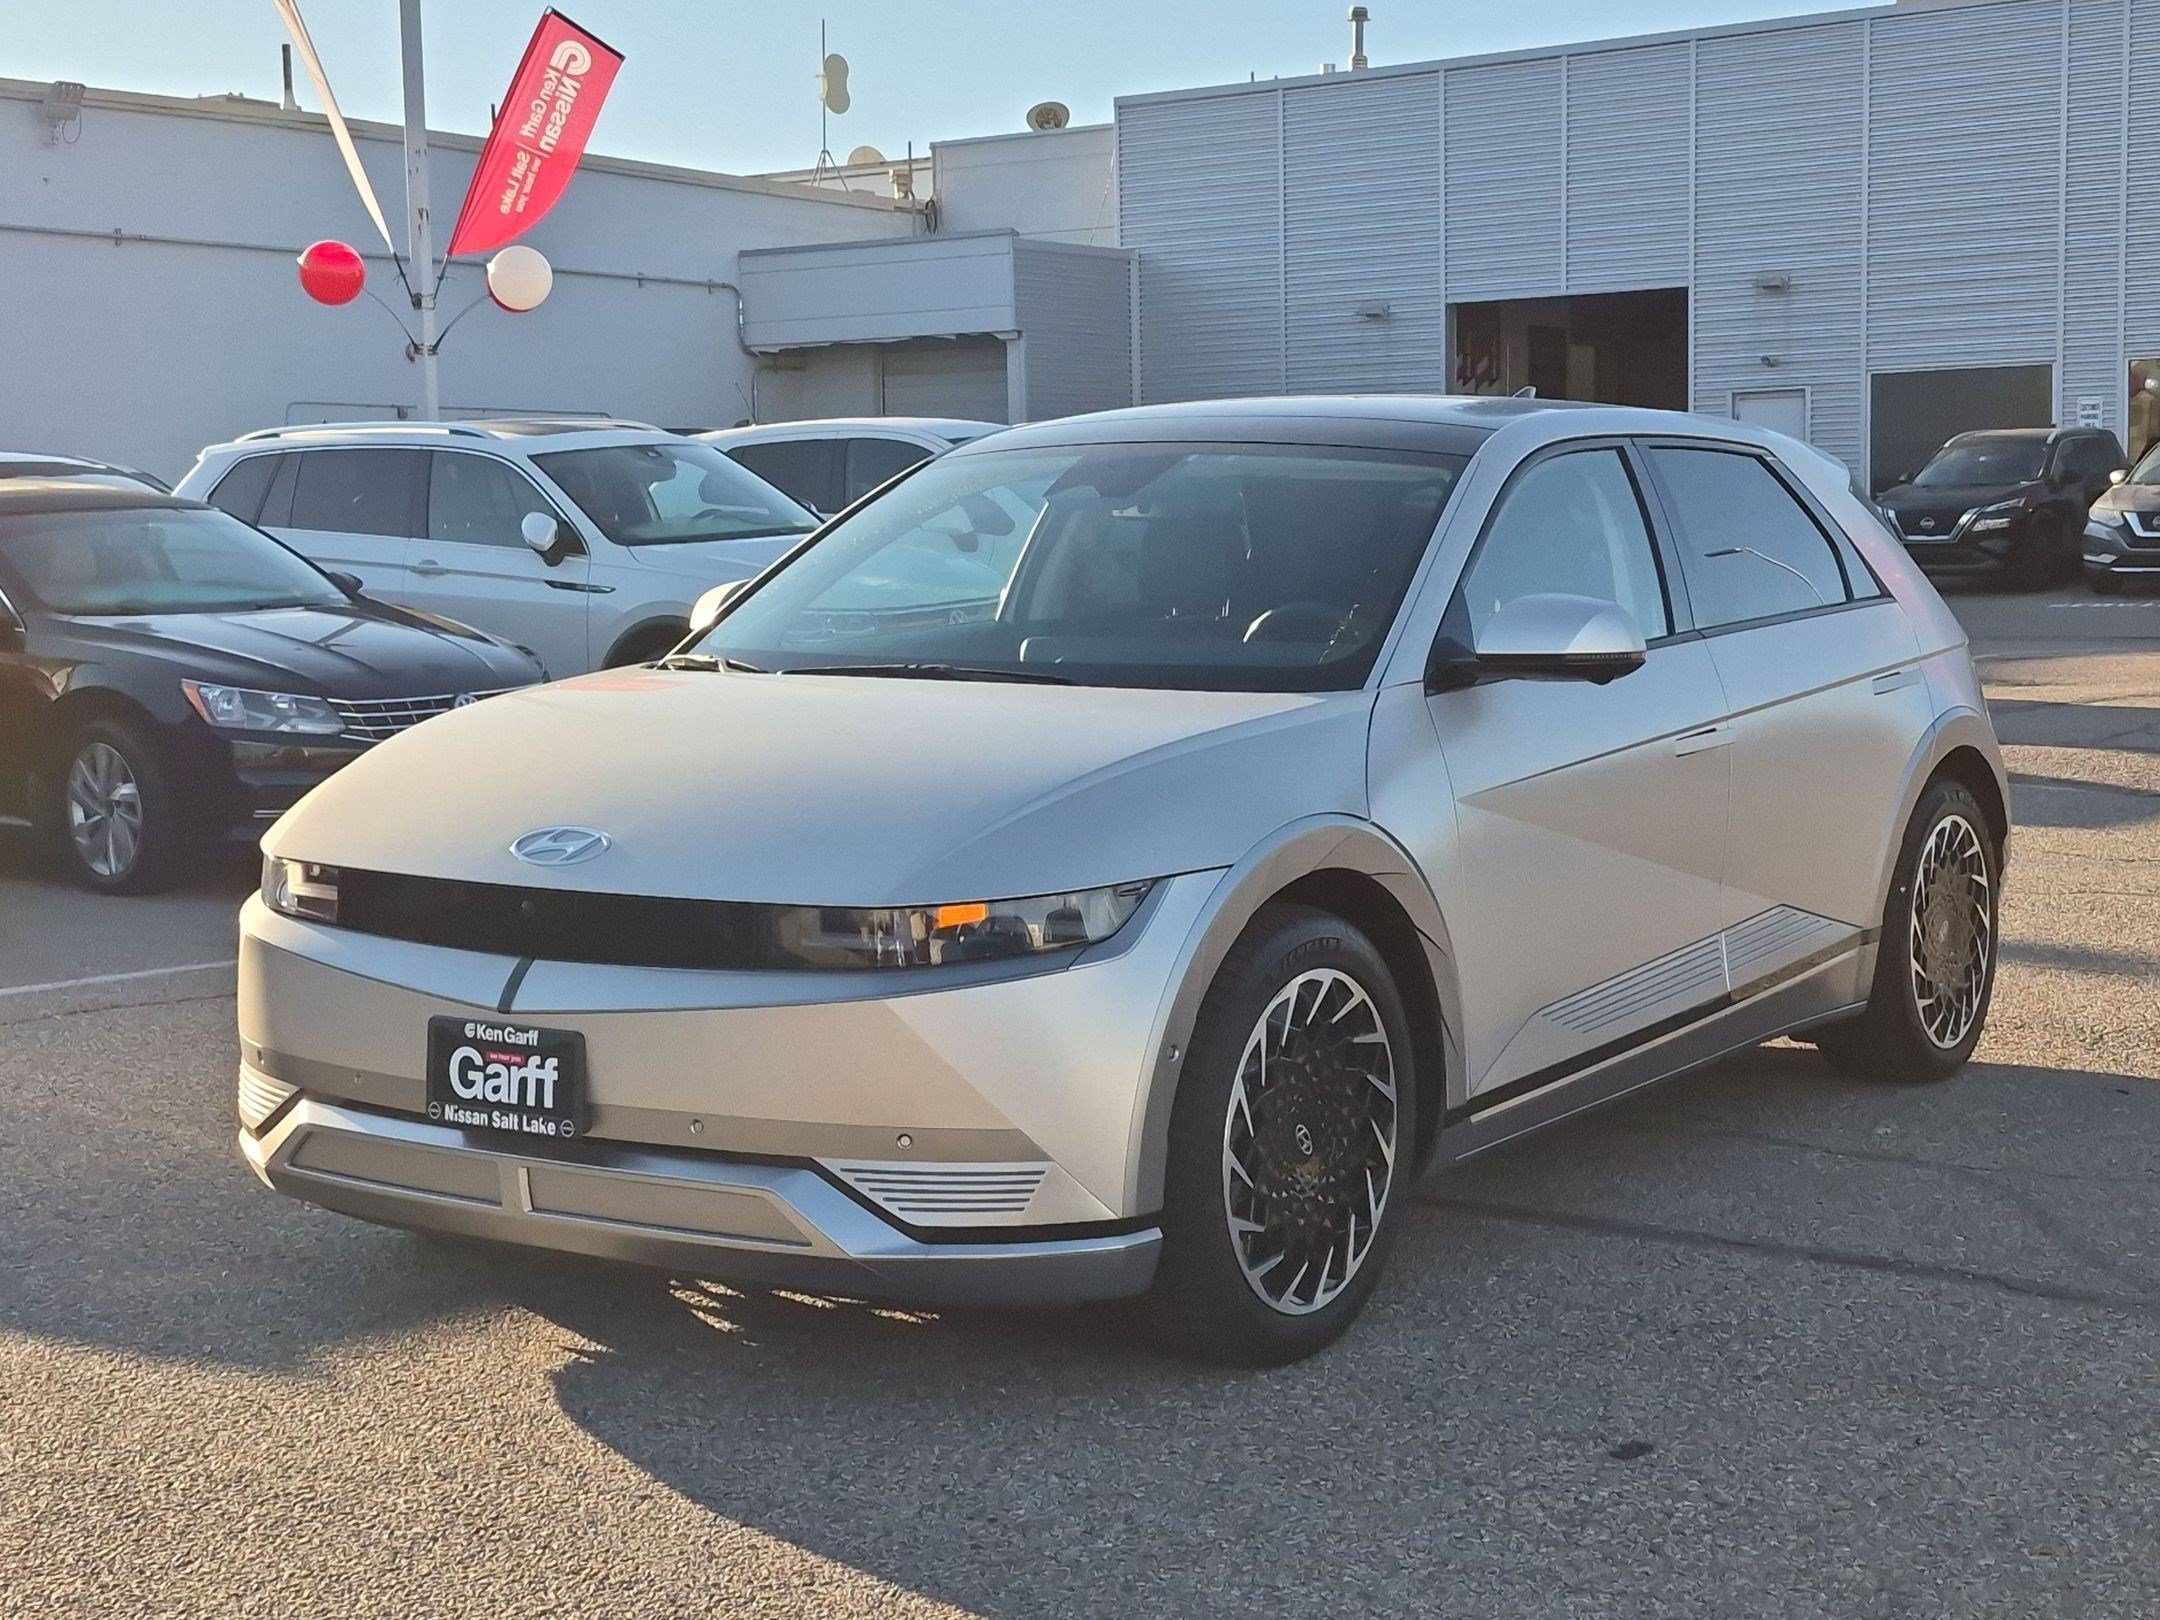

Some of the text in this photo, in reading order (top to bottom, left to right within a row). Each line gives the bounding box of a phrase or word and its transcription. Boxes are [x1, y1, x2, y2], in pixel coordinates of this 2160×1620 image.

[476, 1023, 539, 1046] Ken Garff
[449, 1046, 559, 1109] Garff
[444, 1103, 556, 1136] Nissan Salt Lake
